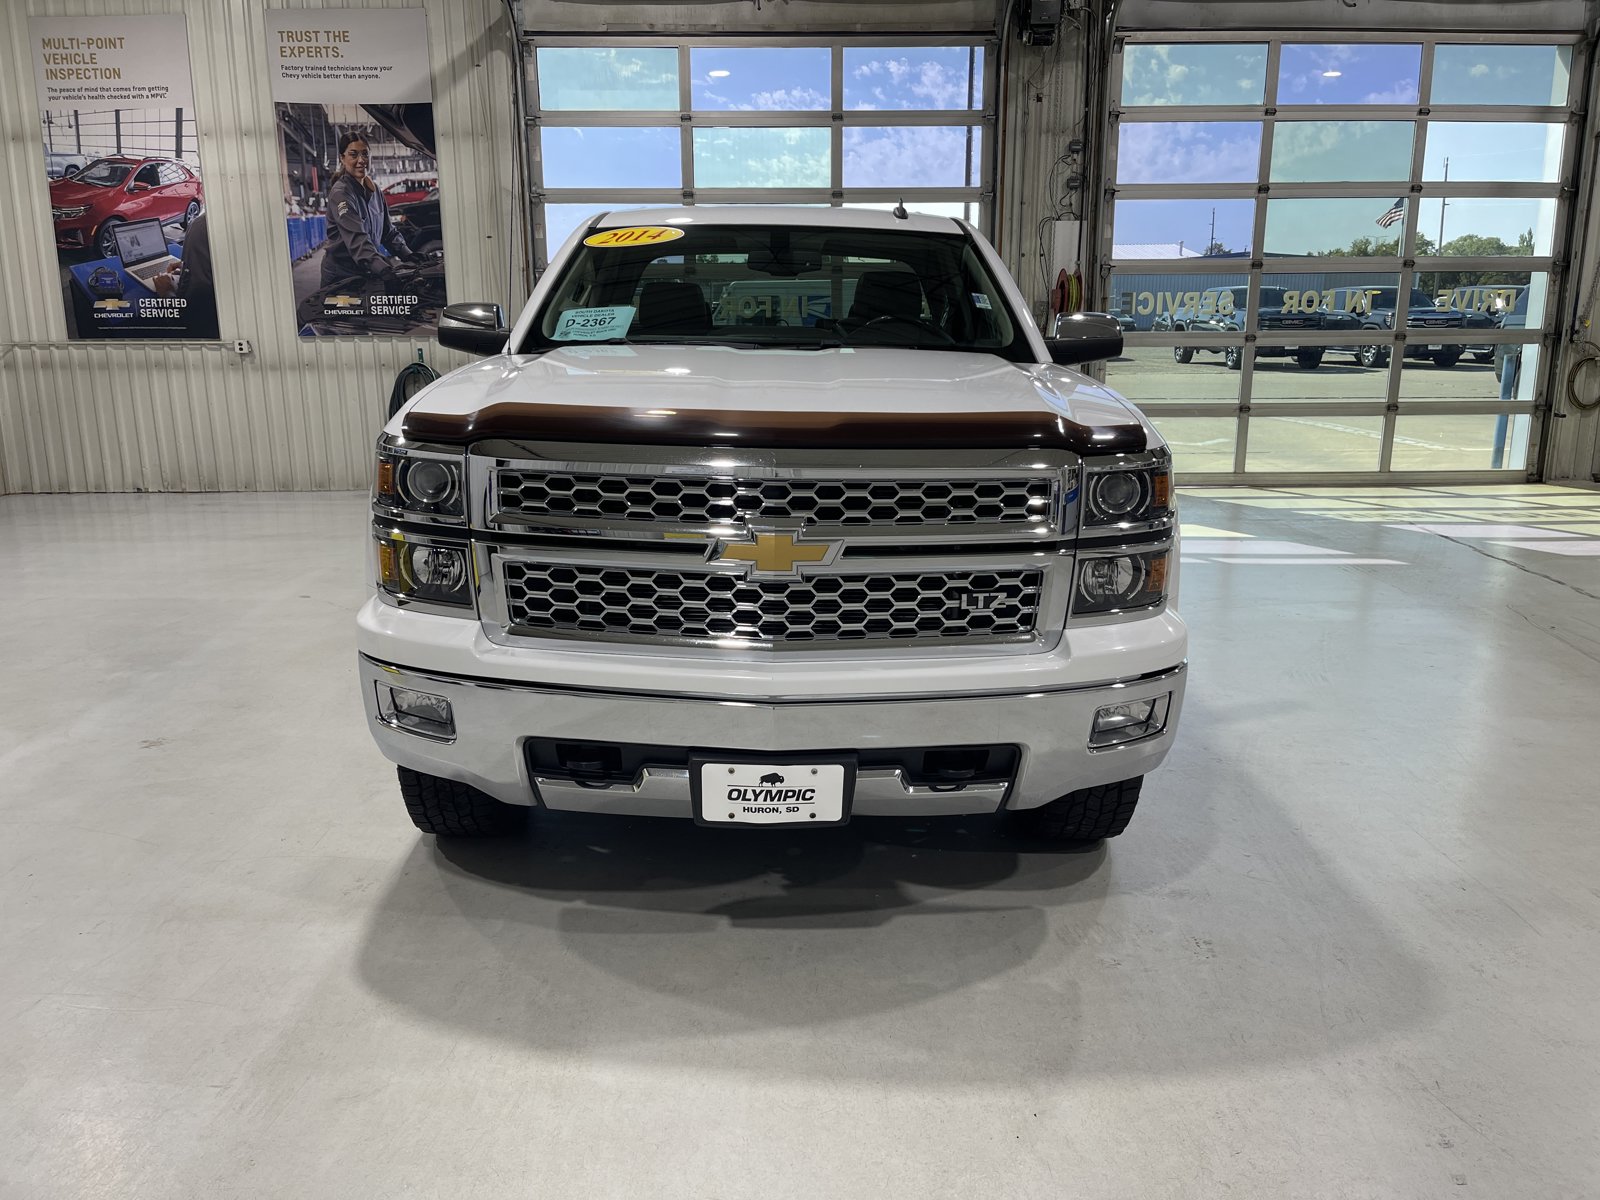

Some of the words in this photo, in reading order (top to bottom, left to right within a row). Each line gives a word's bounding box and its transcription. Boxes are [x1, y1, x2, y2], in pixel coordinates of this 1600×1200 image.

[278, 30, 320, 42] TRUST
[324, 30, 350, 42] THE
[42, 38, 124, 50] MULTI-POINT
[280, 46, 344, 58] EXPERTS.
[43, 53, 98, 65] VEHICLE
[281, 64, 304, 72] Factory
[45, 68, 121, 80] INSPECTION
[148, 85, 168, 93] getting
[598, 229, 668, 244] 2014
[139, 299, 187, 308] CERTIFIED
[370, 295, 418, 304] CERTIFIED
[140, 309, 180, 318] SERVICE
[371, 306, 411, 315] SERVICE
[566, 317, 616, 328] D-2367
[961, 592, 1007, 609] LTZ
[727, 788, 816, 802] OLYMPIC
[742, 806, 782, 814] HURON,
